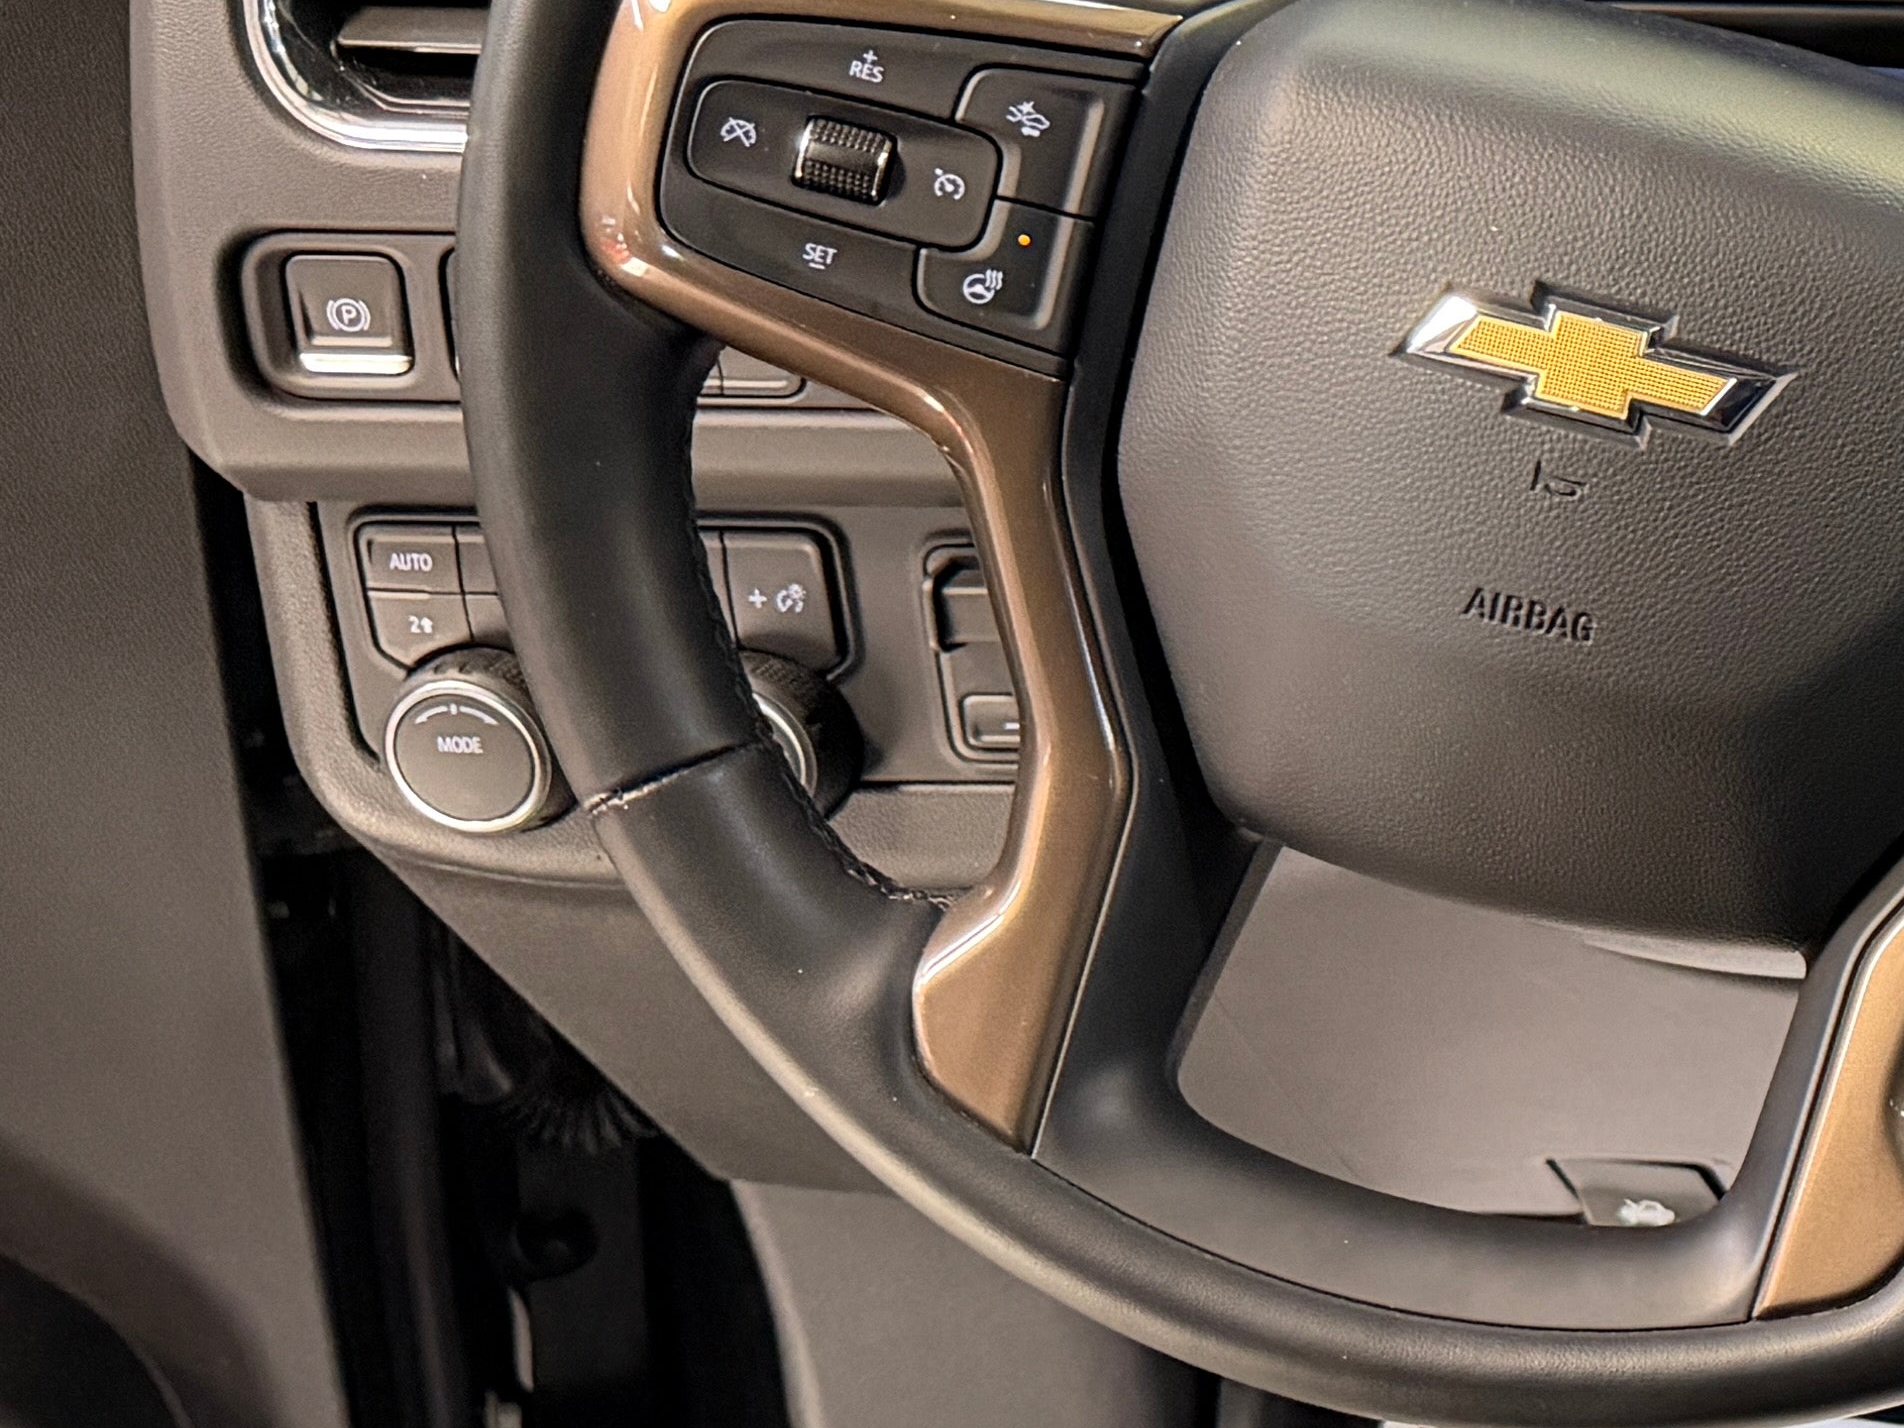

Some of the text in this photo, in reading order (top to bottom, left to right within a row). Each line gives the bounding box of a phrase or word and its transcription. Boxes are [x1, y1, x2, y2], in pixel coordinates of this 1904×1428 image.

[848, 59, 885, 85] RES
[802, 242, 838, 267] SET
[389, 552, 433, 572] AUTO
[1462, 585, 1599, 645] AIRBAG
[436, 735, 484, 755] MODE
